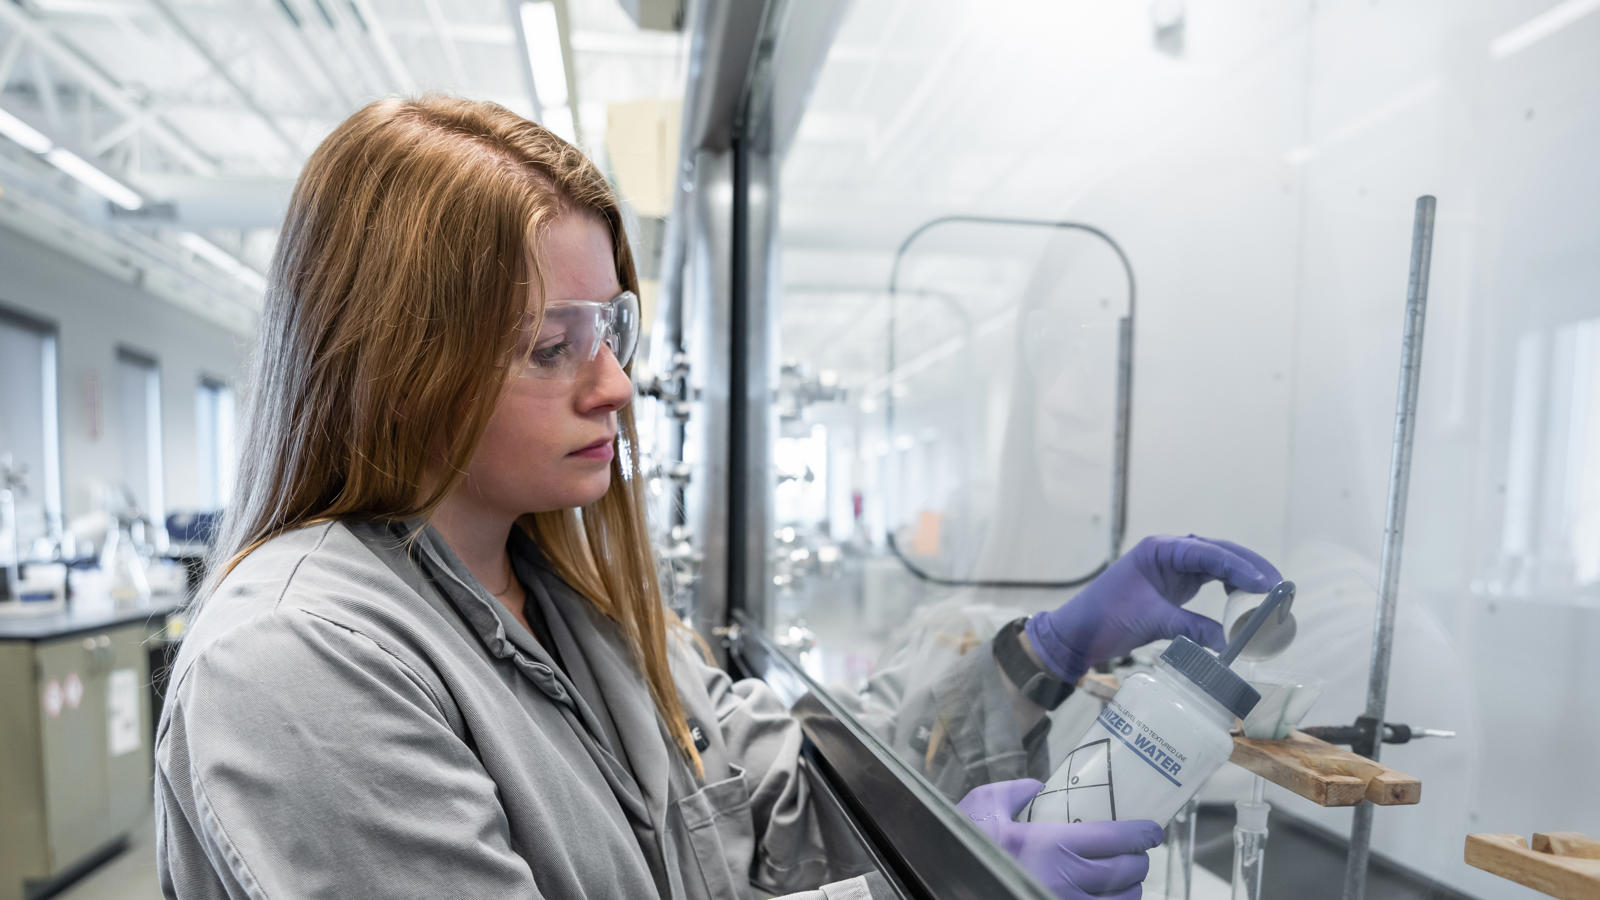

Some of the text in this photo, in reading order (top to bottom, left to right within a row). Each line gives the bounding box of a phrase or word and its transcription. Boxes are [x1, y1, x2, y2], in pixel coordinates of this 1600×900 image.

[1134, 732, 1182, 776] WATER
[1141, 724, 1150, 733] TO
[1148, 729, 1177, 755] TEXTURED
